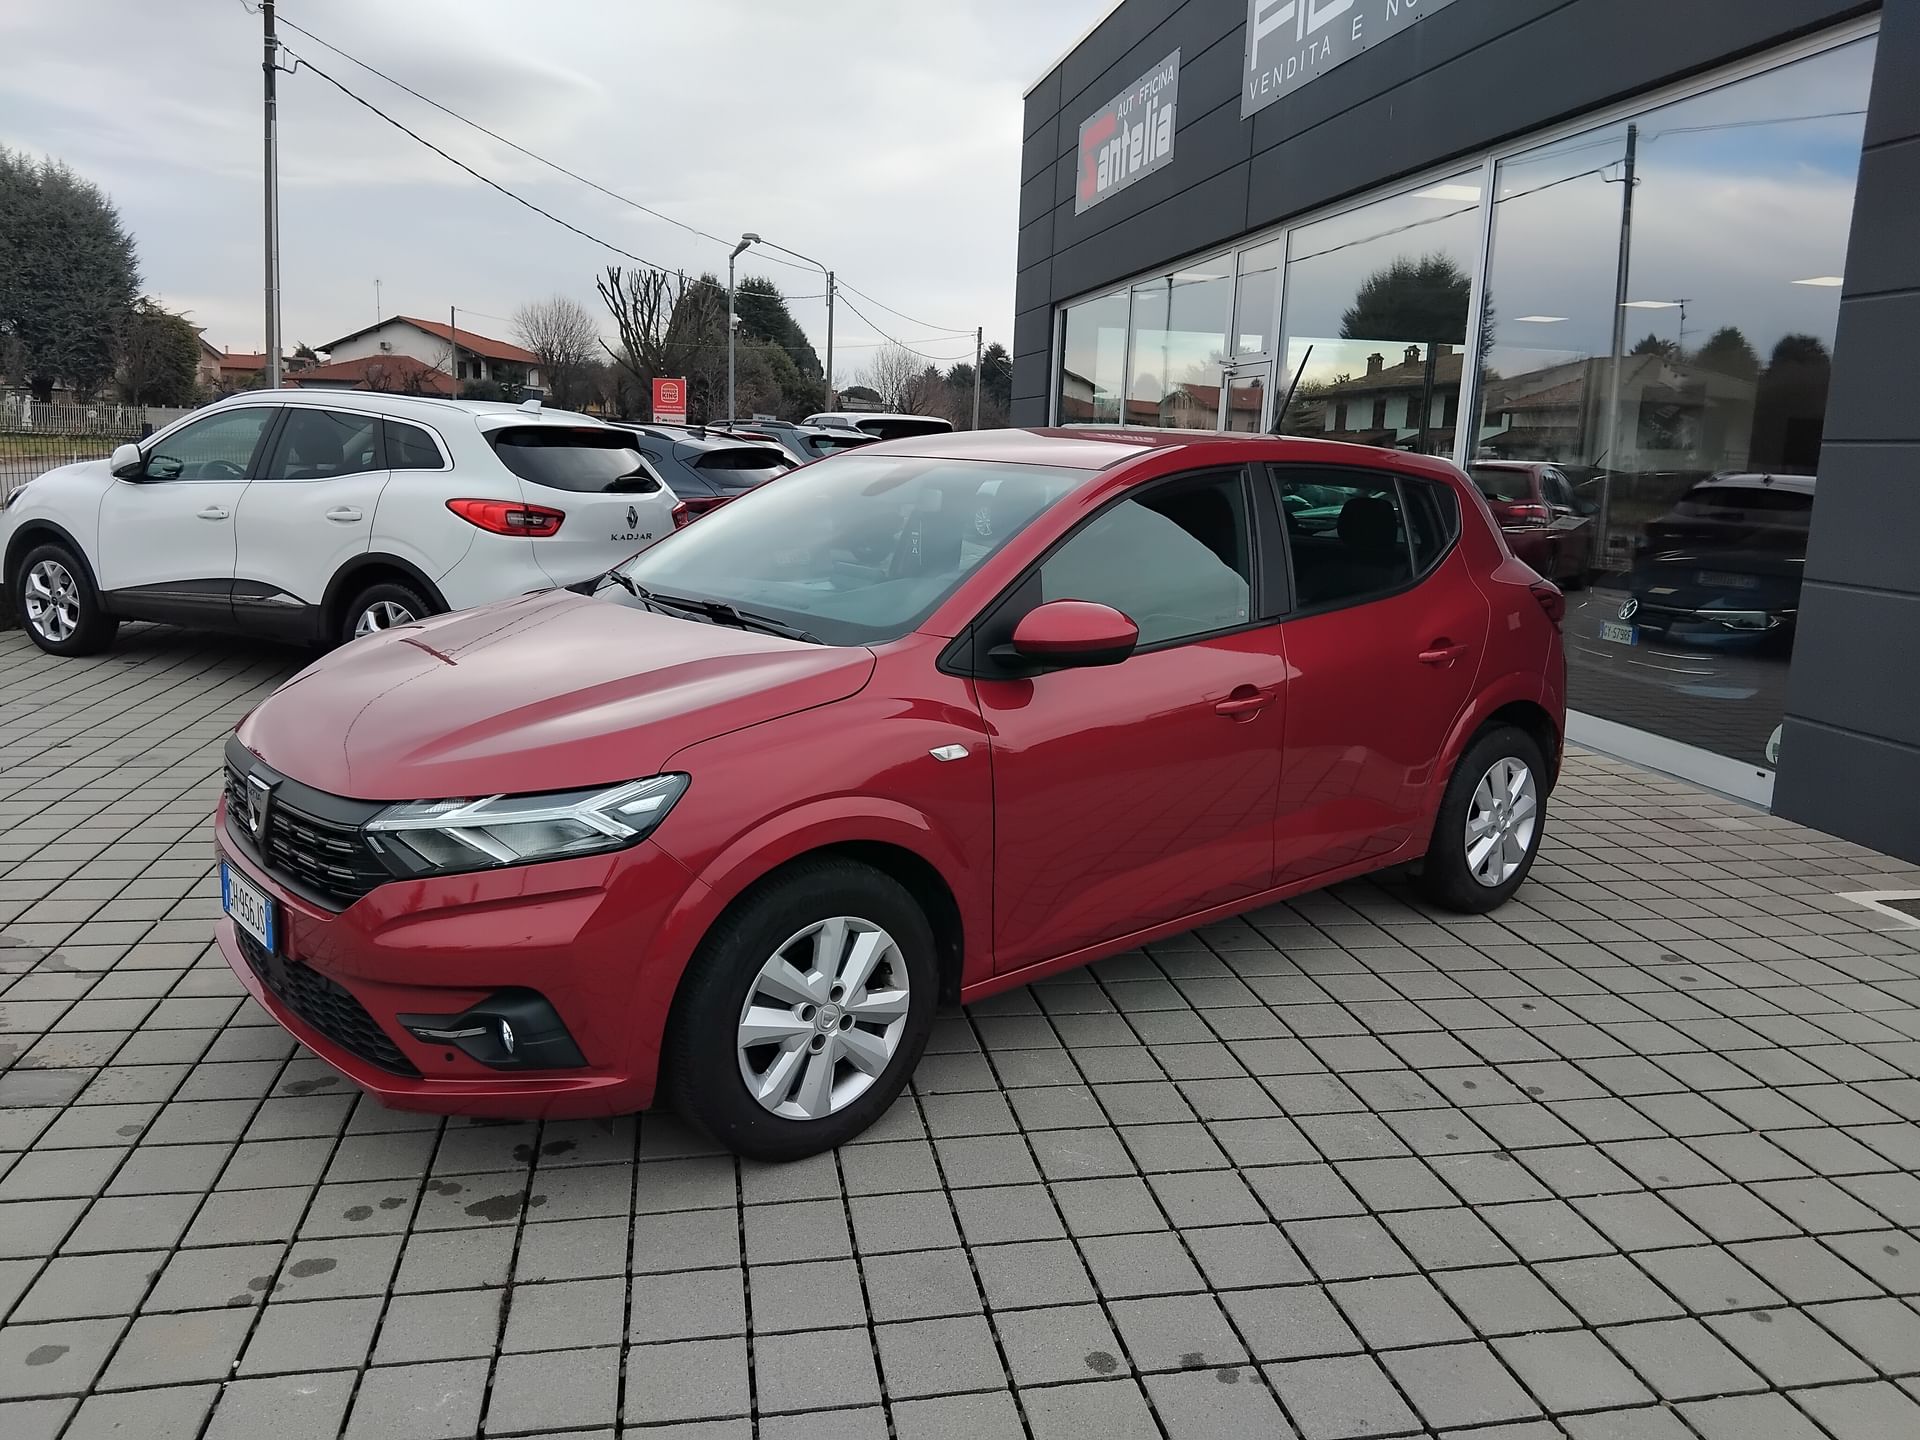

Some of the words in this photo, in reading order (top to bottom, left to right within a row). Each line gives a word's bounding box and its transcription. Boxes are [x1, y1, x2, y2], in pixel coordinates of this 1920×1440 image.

[1250, 35, 1331, 100] VENDITA
[1352, 14, 1363, 41] E
[611, 533, 652, 541] KADJAR
